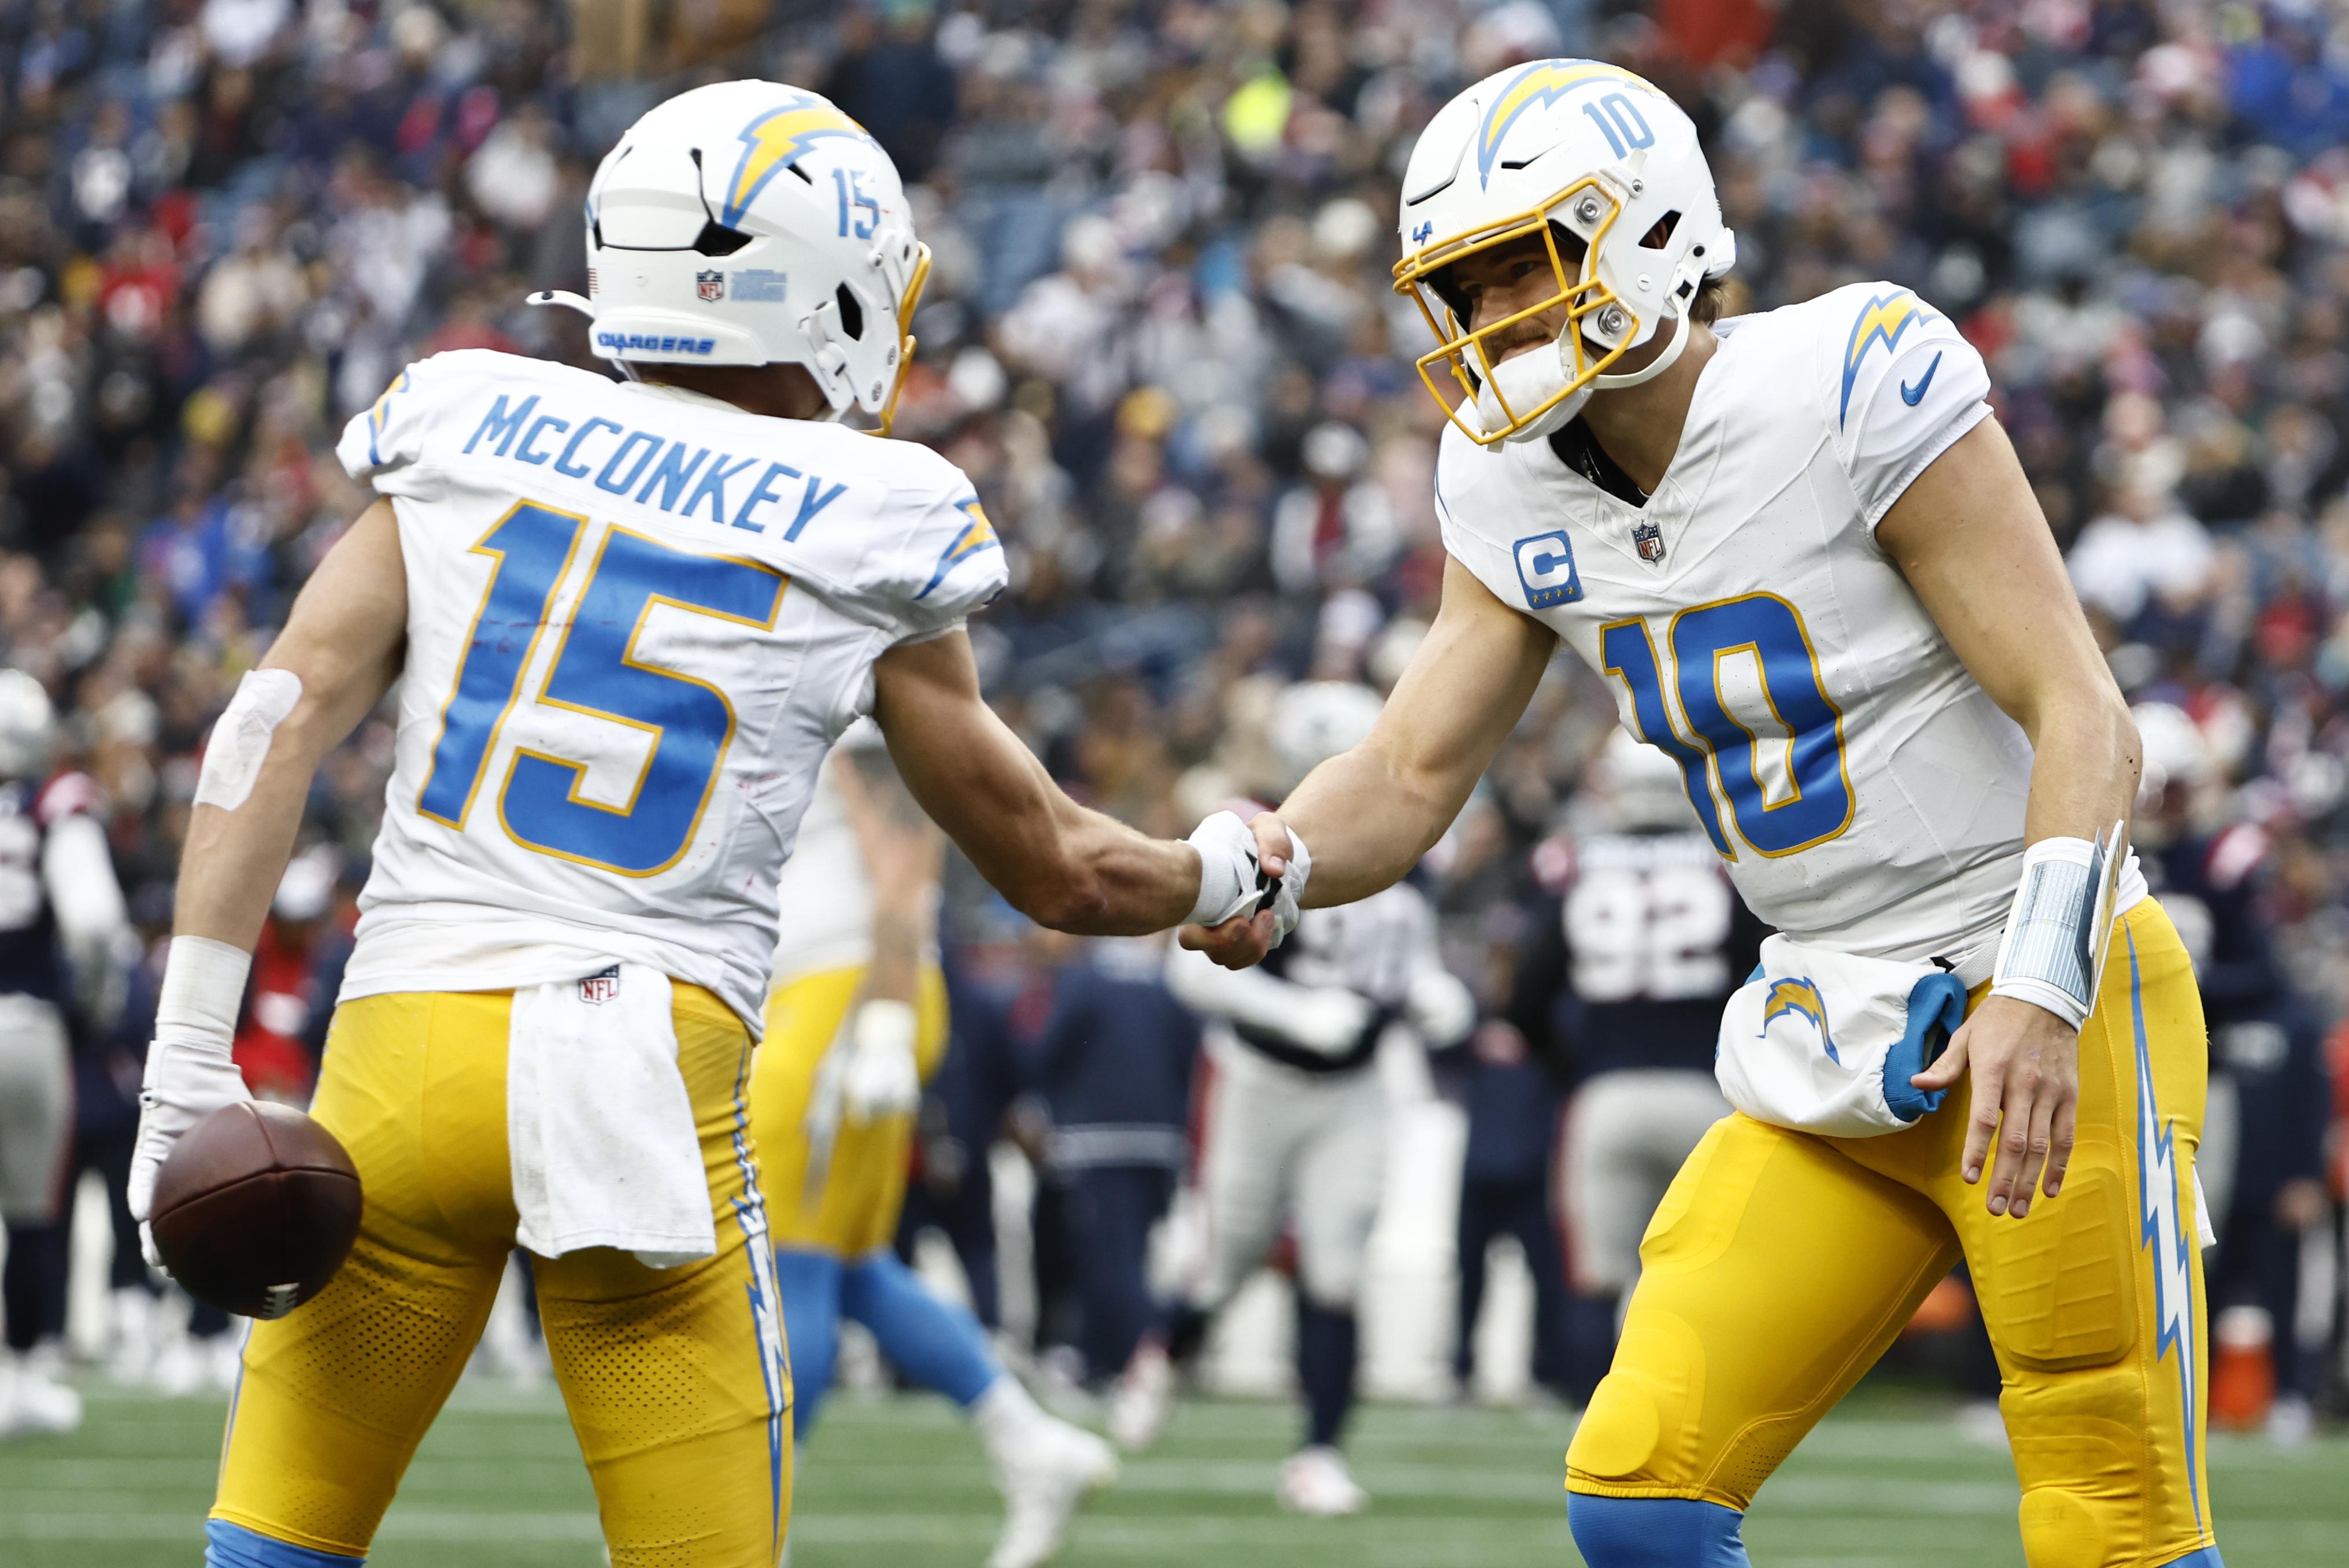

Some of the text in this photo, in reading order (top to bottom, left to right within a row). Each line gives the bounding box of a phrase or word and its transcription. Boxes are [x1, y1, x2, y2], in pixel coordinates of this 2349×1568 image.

[1582, 92, 1655, 160] 10
[831, 168, 880, 240] 15
[699, 283, 723, 297] NFL
[463, 395, 846, 542] McCONKEY
[1517, 537, 1571, 590] C
[1639, 539, 1662, 558] NFL
[417, 498, 790, 878] 15
[1599, 590, 1856, 863] 10
[1563, 868, 1733, 1003] 92
[582, 979, 616, 1001] NFL
